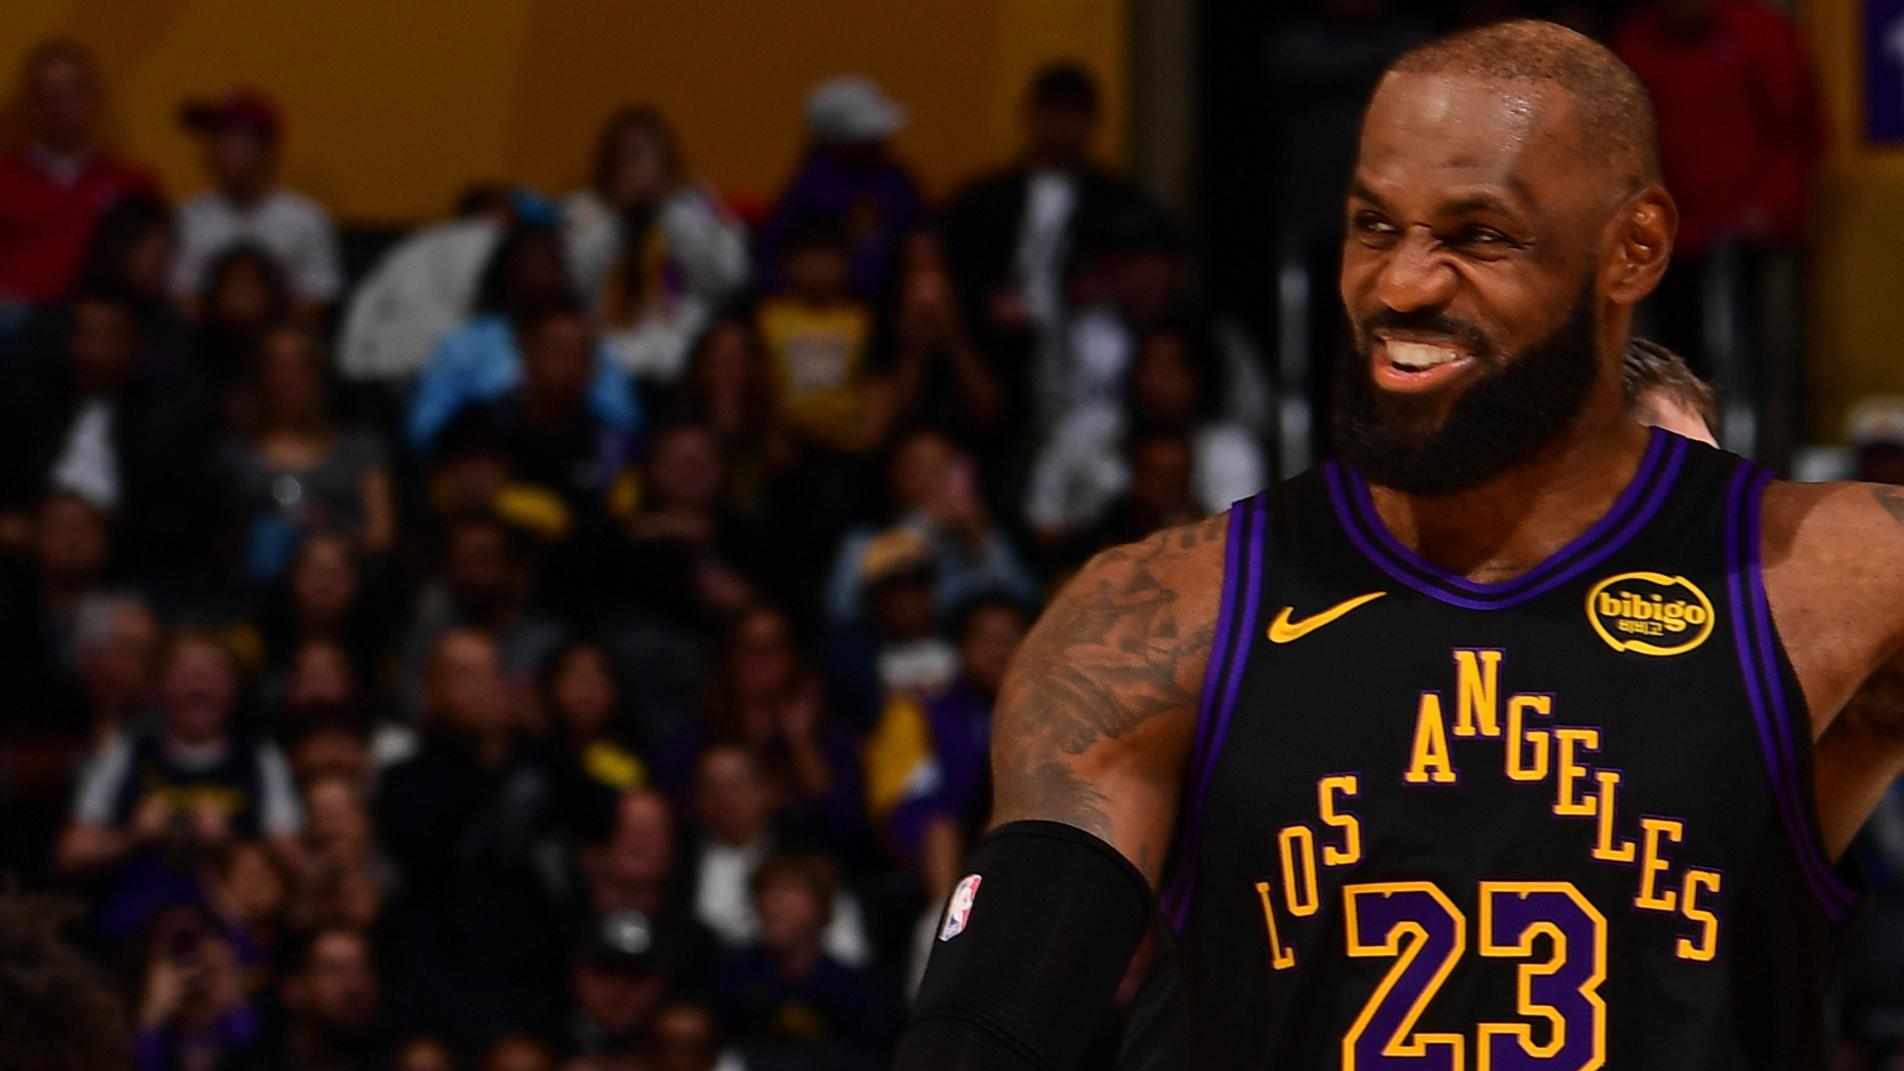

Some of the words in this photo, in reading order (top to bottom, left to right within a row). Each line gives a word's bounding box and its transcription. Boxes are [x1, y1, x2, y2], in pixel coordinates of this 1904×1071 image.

[1600, 590, 1706, 632] bibigo
[1256, 775, 1361, 970] LOS
[1406, 650, 1721, 962] ANGELES
